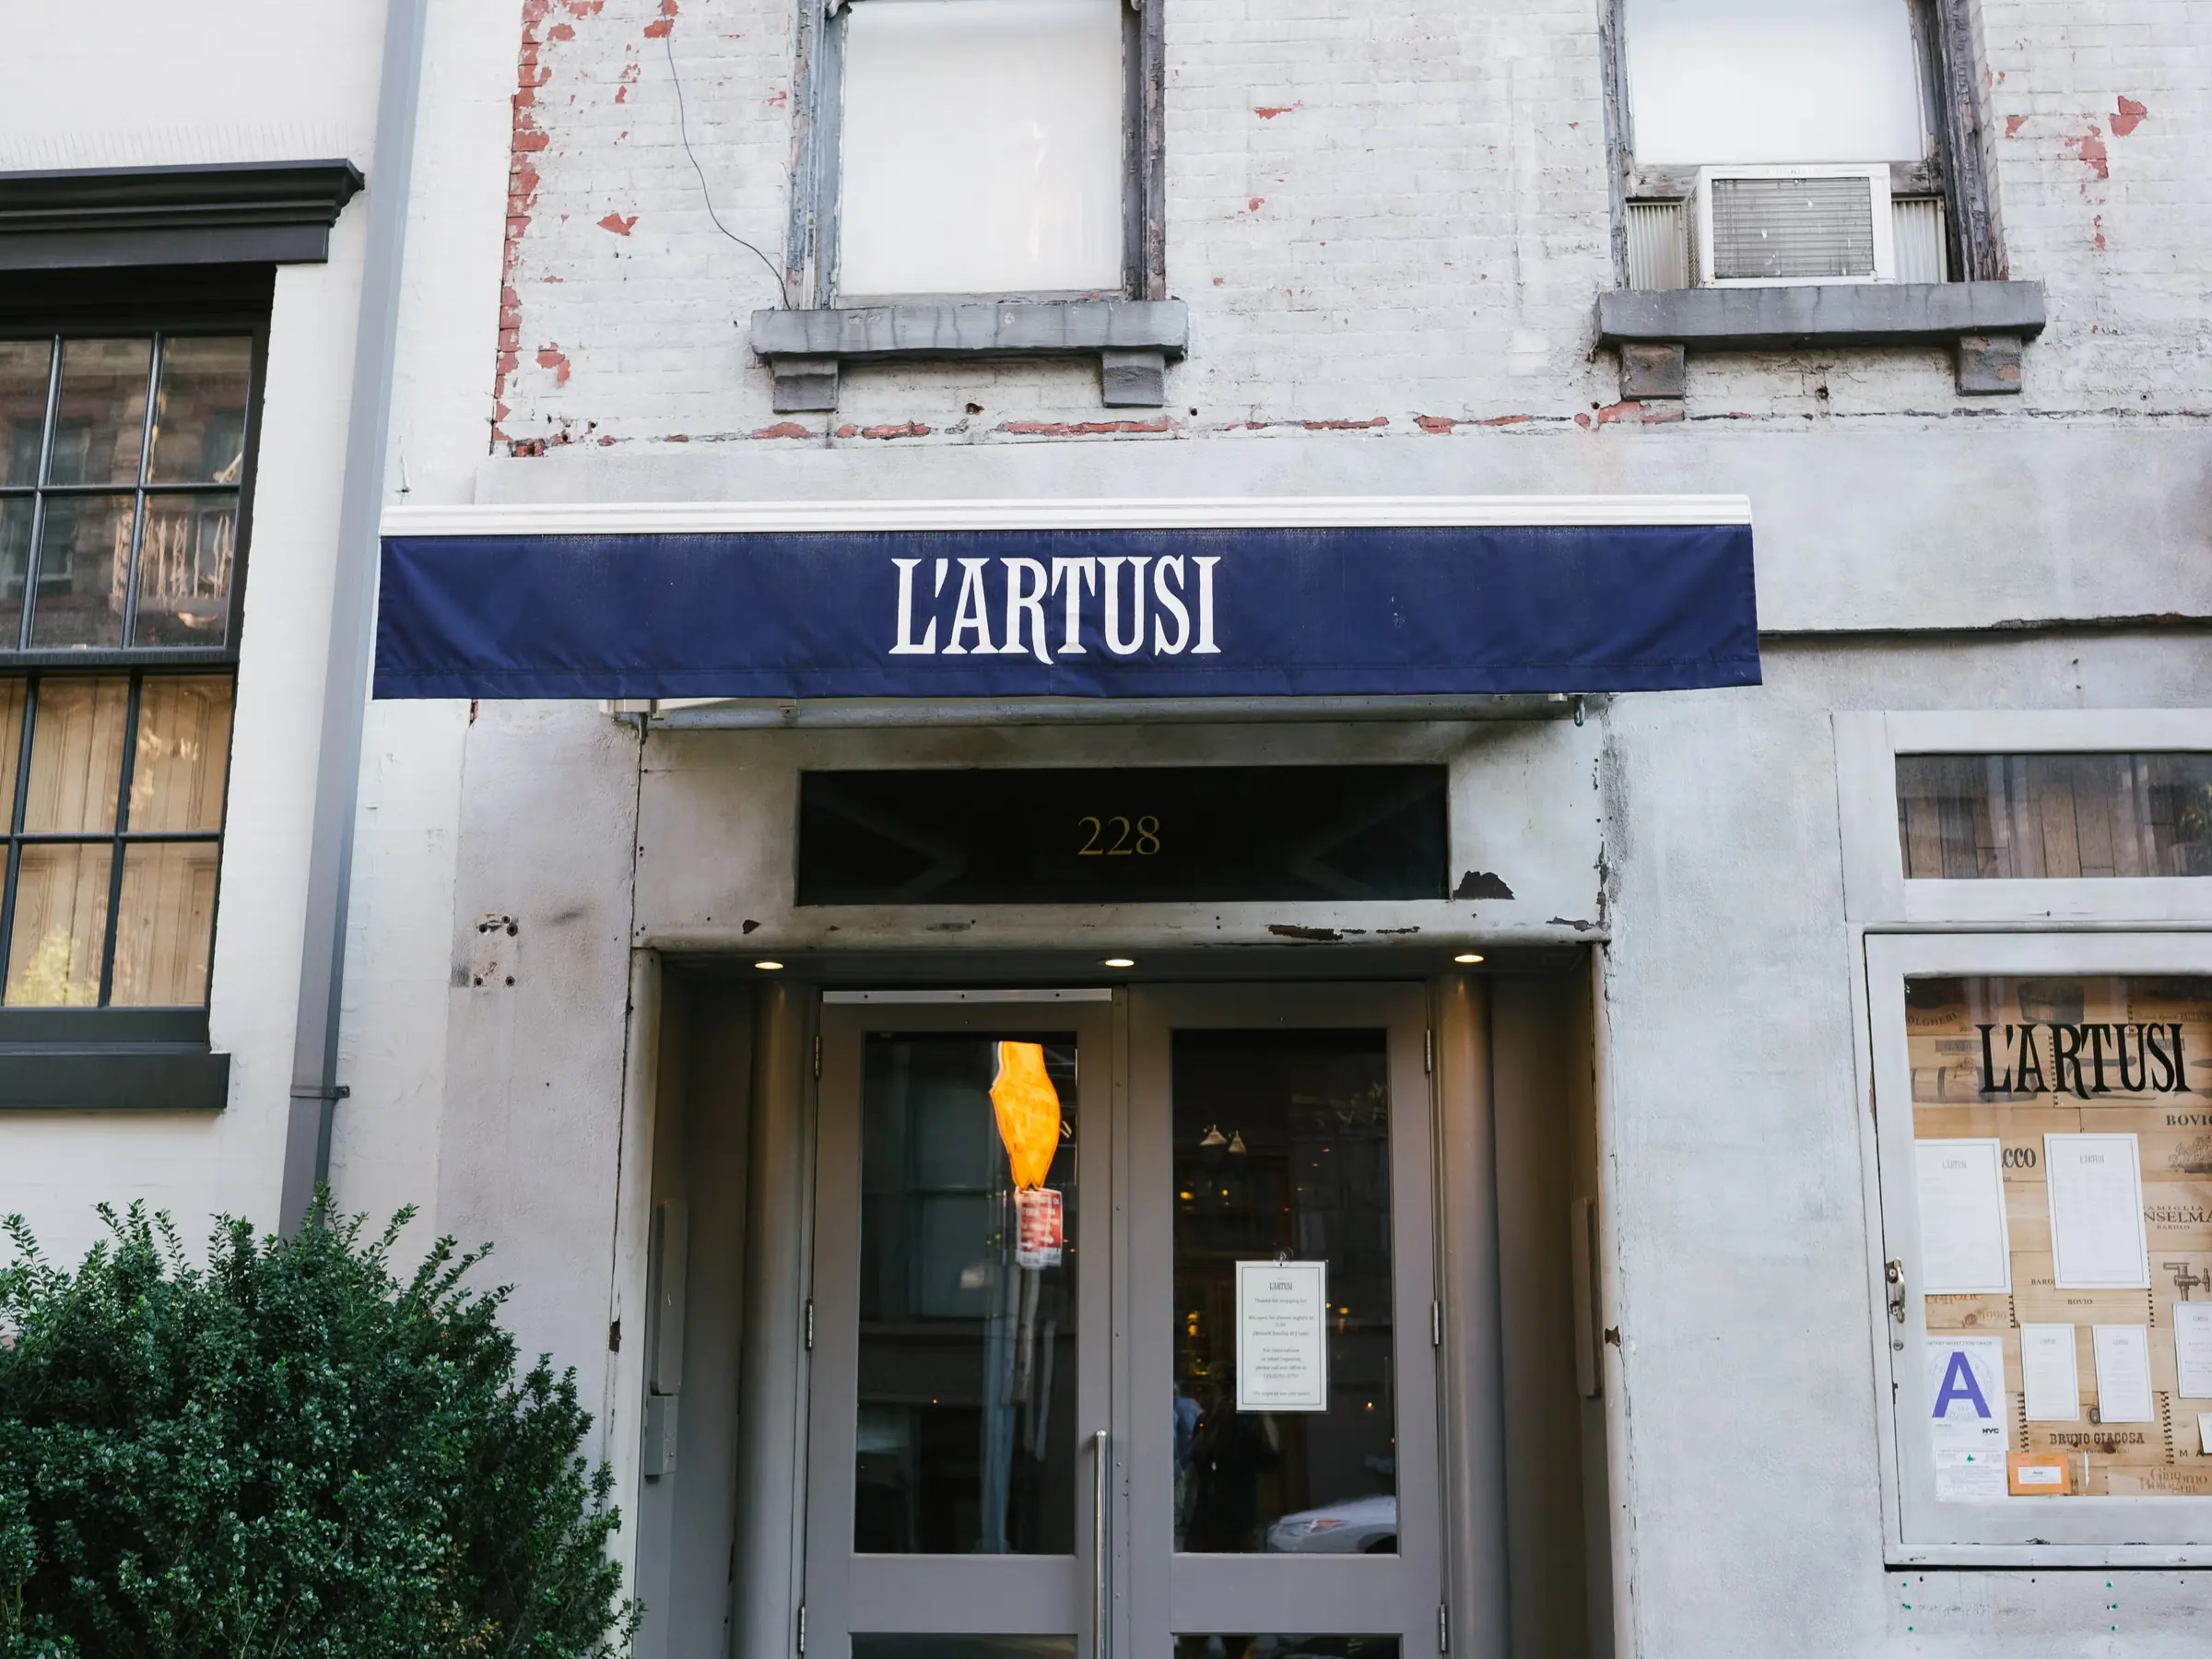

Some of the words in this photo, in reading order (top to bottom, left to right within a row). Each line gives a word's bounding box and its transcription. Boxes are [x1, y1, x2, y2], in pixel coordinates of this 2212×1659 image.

[888, 554, 1221, 665] L'ARTUSI
[1077, 816, 1160, 855] 228
[1974, 1022, 2193, 1100] L'ARTUSI
[2002, 1147, 2036, 1168] CCO
[1932, 1351, 1992, 1418] A
[2049, 1433, 2090, 1445] BRUNO
[2094, 1432, 2145, 1445] GIACOSA
